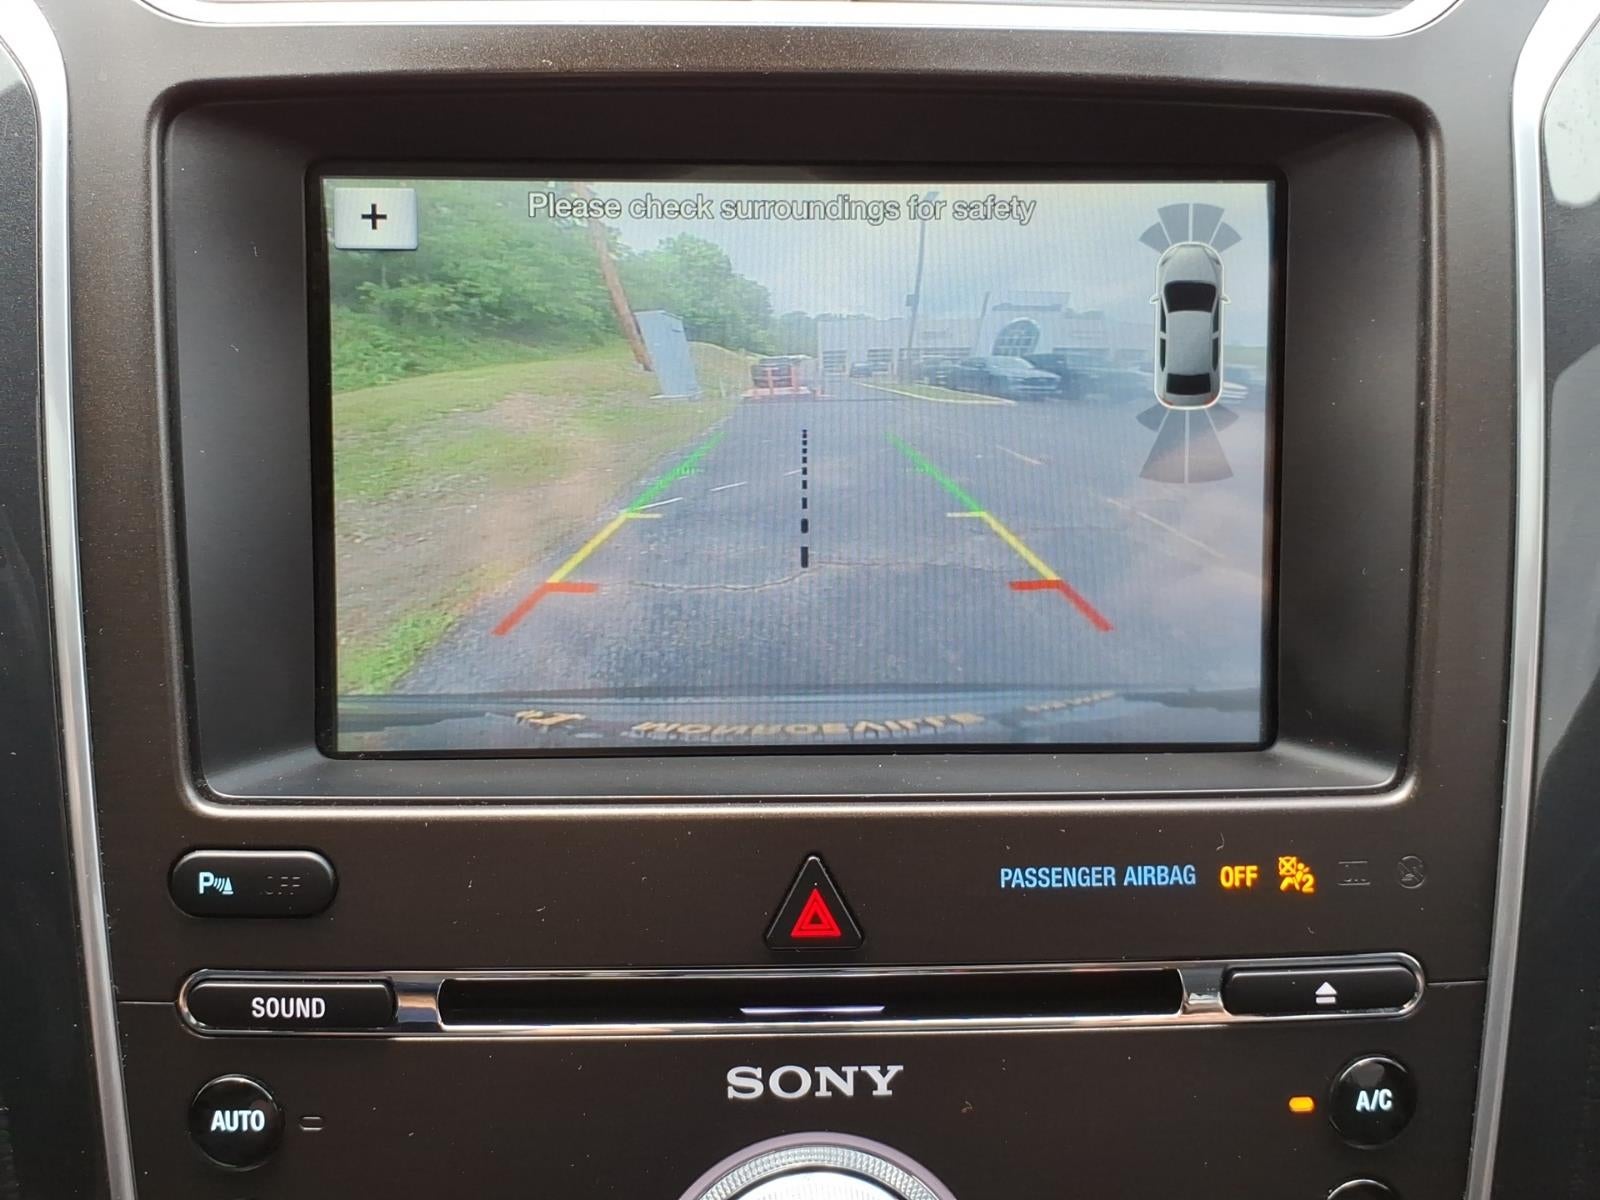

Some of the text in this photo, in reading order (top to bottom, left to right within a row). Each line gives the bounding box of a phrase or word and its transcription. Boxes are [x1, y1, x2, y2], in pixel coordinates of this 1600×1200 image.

[528, 191, 1036, 226] Please check surroundings for safety
[1000, 864, 1259, 889] PASSENGER AIRBAG OFF
[251, 997, 326, 1019] SOUND
[726, 1065, 904, 1099] SONY
[1356, 1088, 1394, 1112] A/C
[210, 1110, 265, 1133] AUTO
